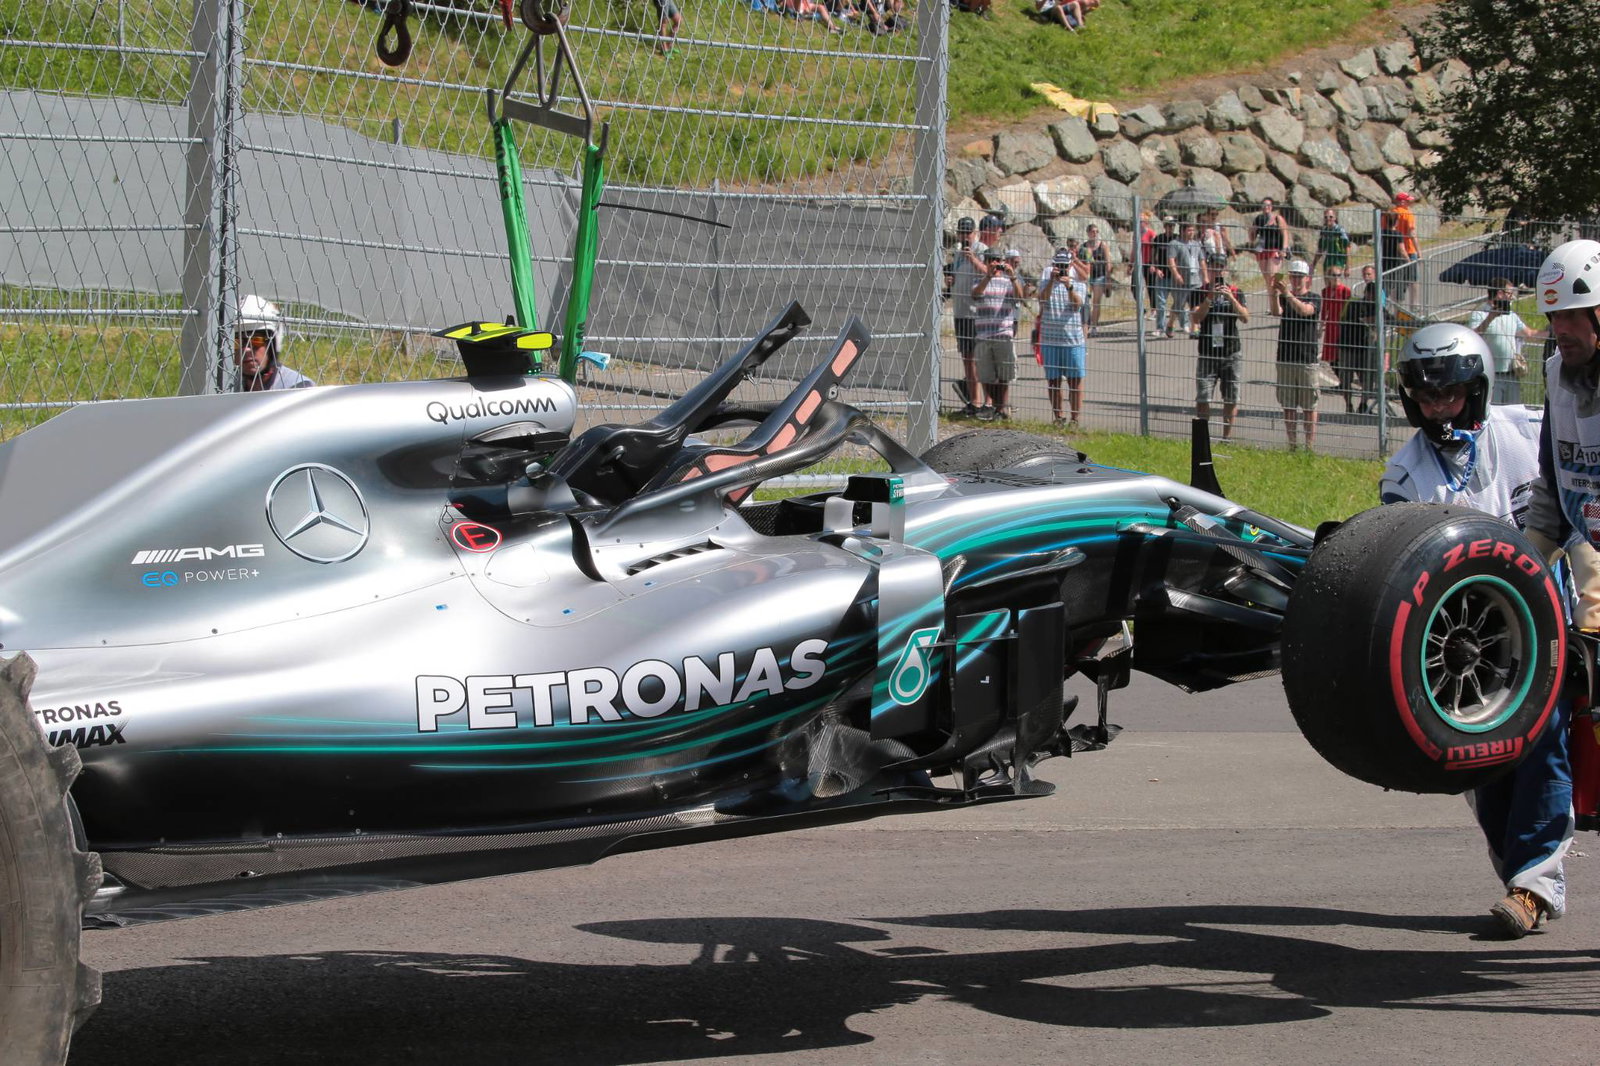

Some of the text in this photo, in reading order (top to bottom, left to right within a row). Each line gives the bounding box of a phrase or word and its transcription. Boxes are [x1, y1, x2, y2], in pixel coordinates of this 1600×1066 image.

[426, 396, 557, 425] Qualcomm
[460, 525, 494, 549] E
[173, 544, 265, 562] AMG
[142, 570, 179, 587] EQ
[1412, 539, 1542, 607] P ZERO
[415, 638, 830, 733] PETRONAS
[1445, 736, 1525, 770] PIRELLI
